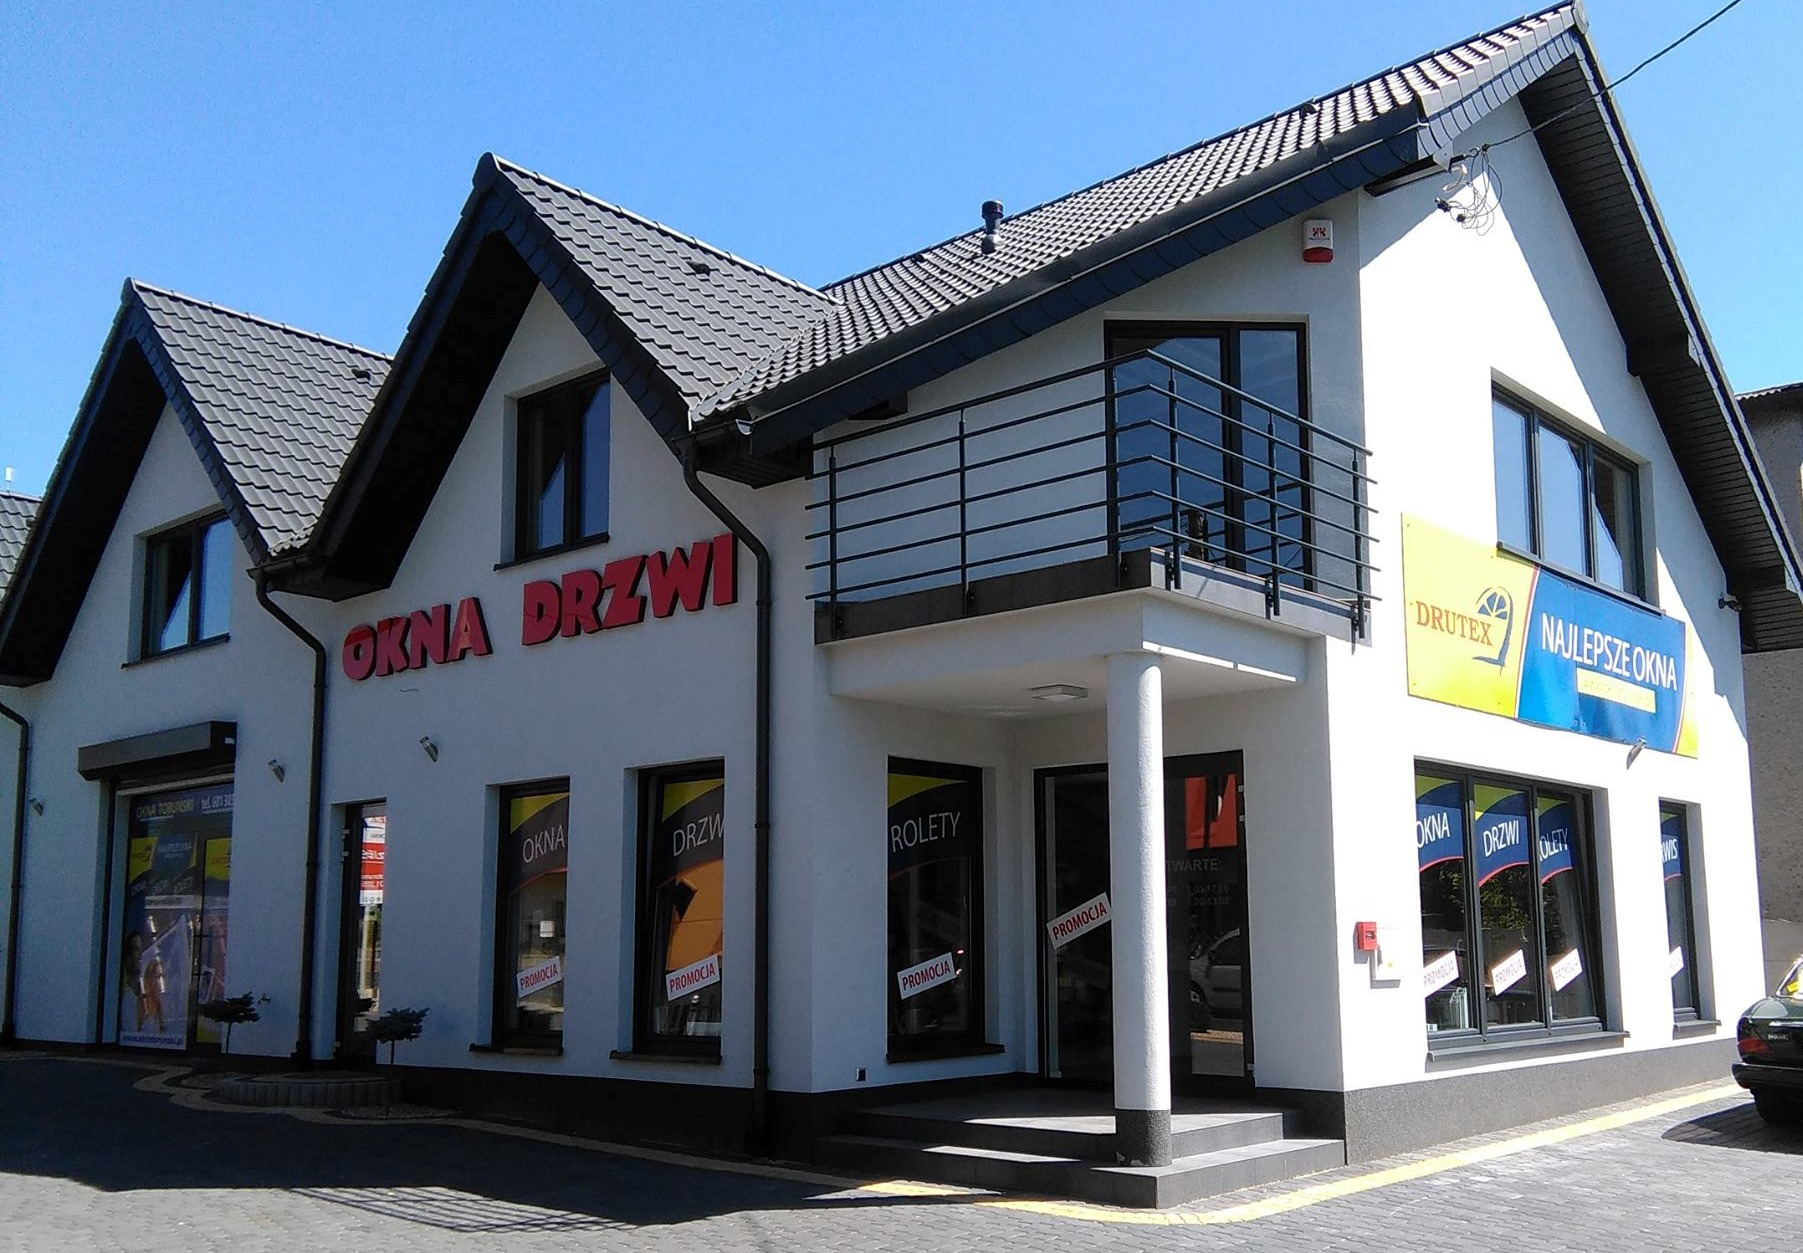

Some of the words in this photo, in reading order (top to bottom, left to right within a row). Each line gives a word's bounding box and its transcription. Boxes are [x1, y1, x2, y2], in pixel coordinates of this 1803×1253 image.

[343, 597, 493, 681] OKNA
[521, 533, 738, 647] DRZWI
[1415, 601, 1494, 647] DRUTEX
[1541, 612, 1631, 677] NAJLEPSZE
[1632, 646, 1678, 692] OKNA
[522, 824, 565, 863] OKNA
[673, 812, 725, 857] DRZW
[891, 811, 961, 854] ROLETY
[1417, 812, 1451, 849] OKNA
[1483, 820, 1520, 857] DRZWI
[1166, 858, 1223, 872] TWARTE:
[1052, 901, 1108, 941] PROMOCJA
[519, 963, 559, 991] PROMOCJA
[669, 962, 716, 993] PROMOCJA
[902, 960, 951, 991] PROMOCJA
